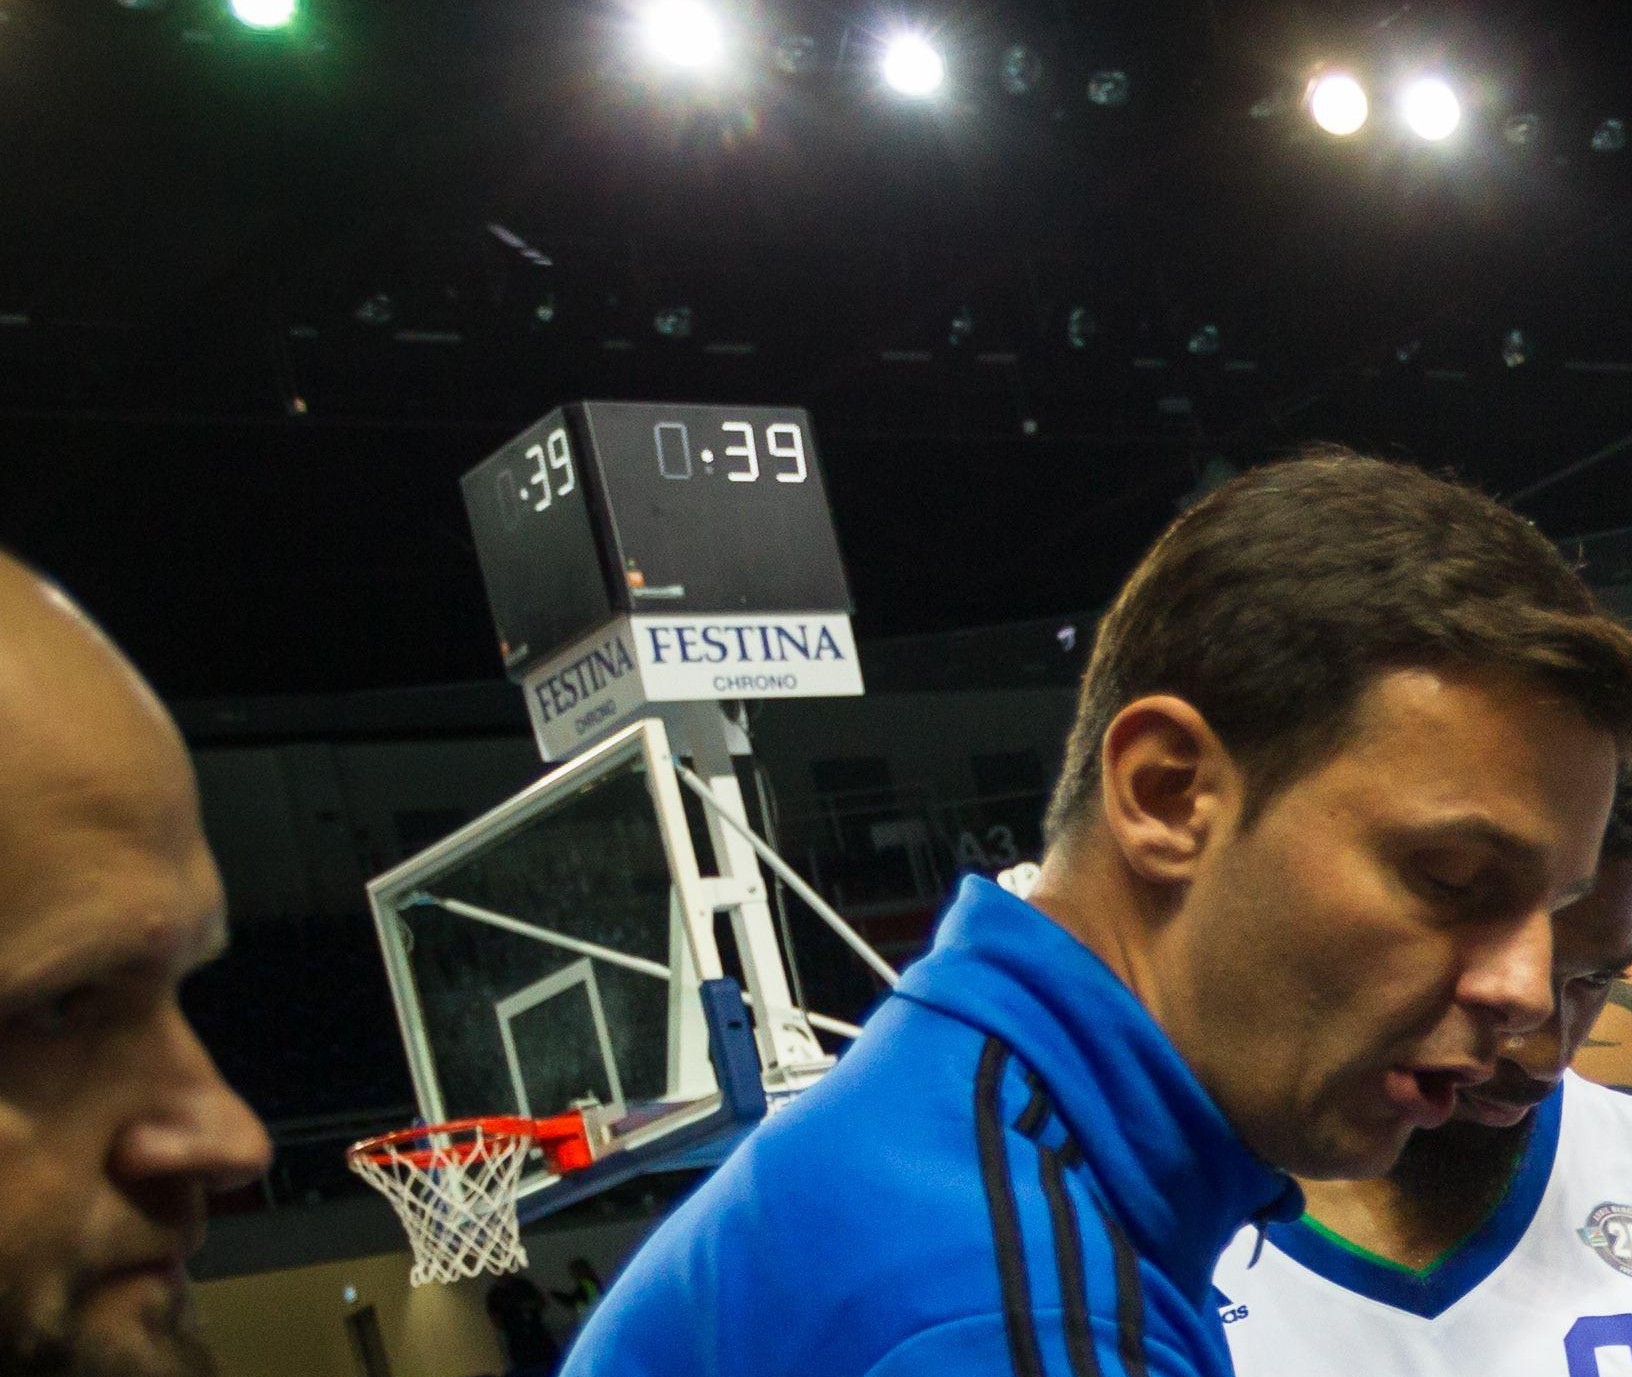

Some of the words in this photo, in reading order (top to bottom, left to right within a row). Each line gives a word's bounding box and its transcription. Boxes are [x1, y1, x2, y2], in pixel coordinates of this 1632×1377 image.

[646, 625, 847, 664] FESTINA
[534, 636, 634, 724] FESTINA
[713, 674, 798, 692] CHRONO
